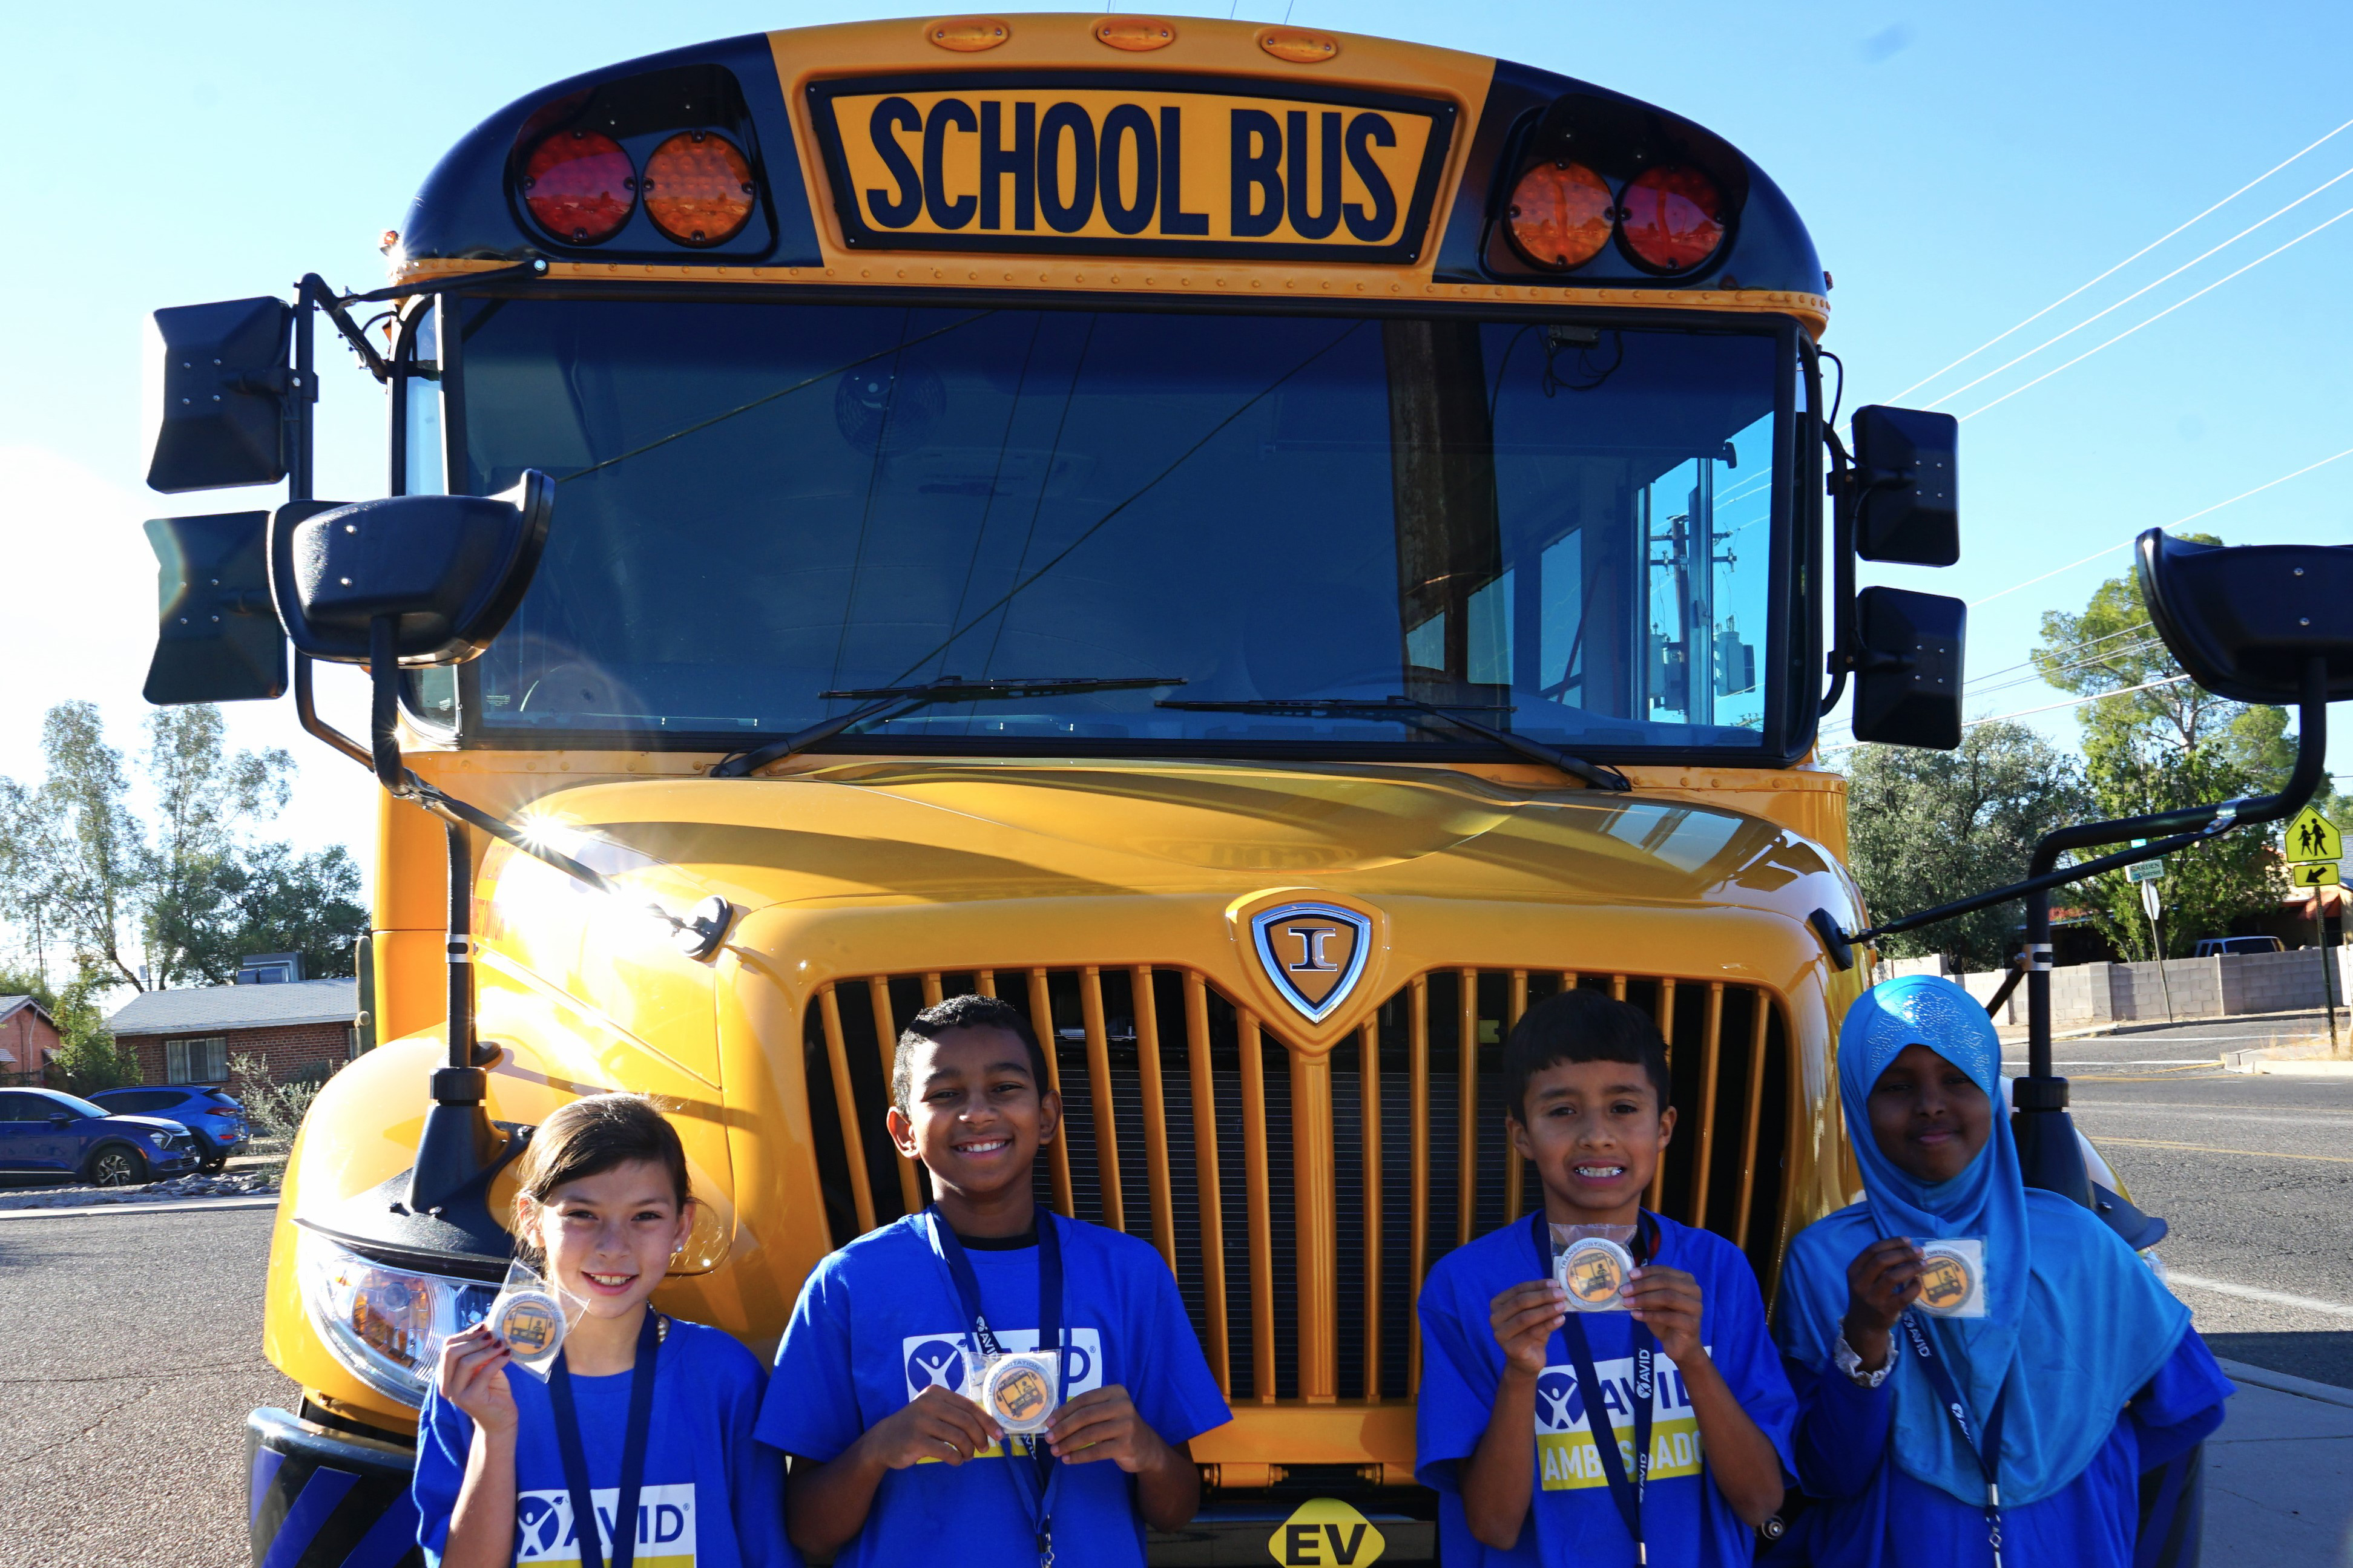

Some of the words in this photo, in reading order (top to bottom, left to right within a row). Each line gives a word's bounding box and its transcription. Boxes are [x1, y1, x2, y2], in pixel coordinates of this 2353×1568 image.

[866, 97, 1209, 235] SCHOOL
[1231, 108, 1397, 242] BUS
[2131, 863, 2160, 871] GARDEN
[1561, 1242, 1619, 1270] TRANSPORTATION
[1910, 1328, 1930, 1357] AVID
[1638, 1350, 1650, 1383] AVID
[1286, 1524, 1367, 1566] EV
